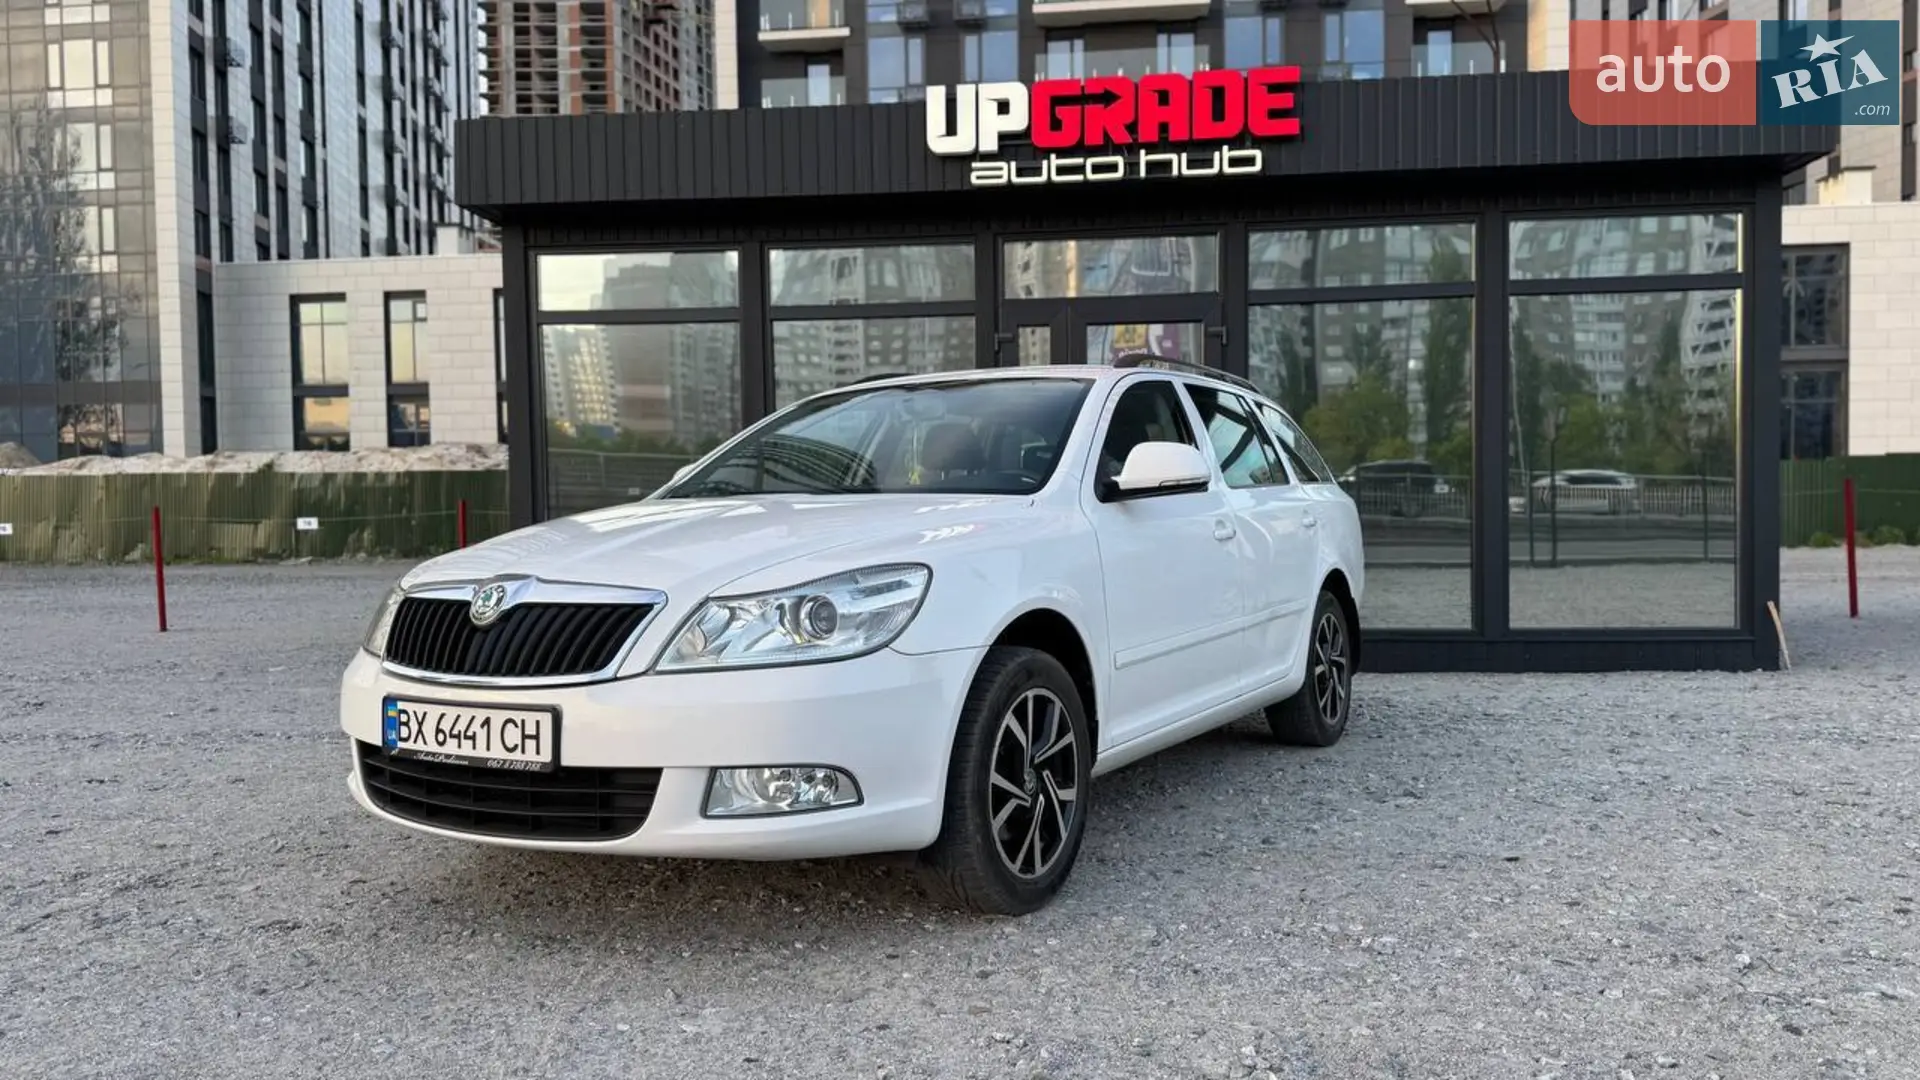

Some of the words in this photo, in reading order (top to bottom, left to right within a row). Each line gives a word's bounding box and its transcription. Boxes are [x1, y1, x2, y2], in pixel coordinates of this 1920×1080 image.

[926, 65, 1301, 156] UPGRADE
[970, 153, 1124, 186] auto
[1139, 145, 1263, 179] hub
[398, 708, 428, 746] BX
[434, 713, 491, 752] 6441
[500, 717, 541, 756] CH
